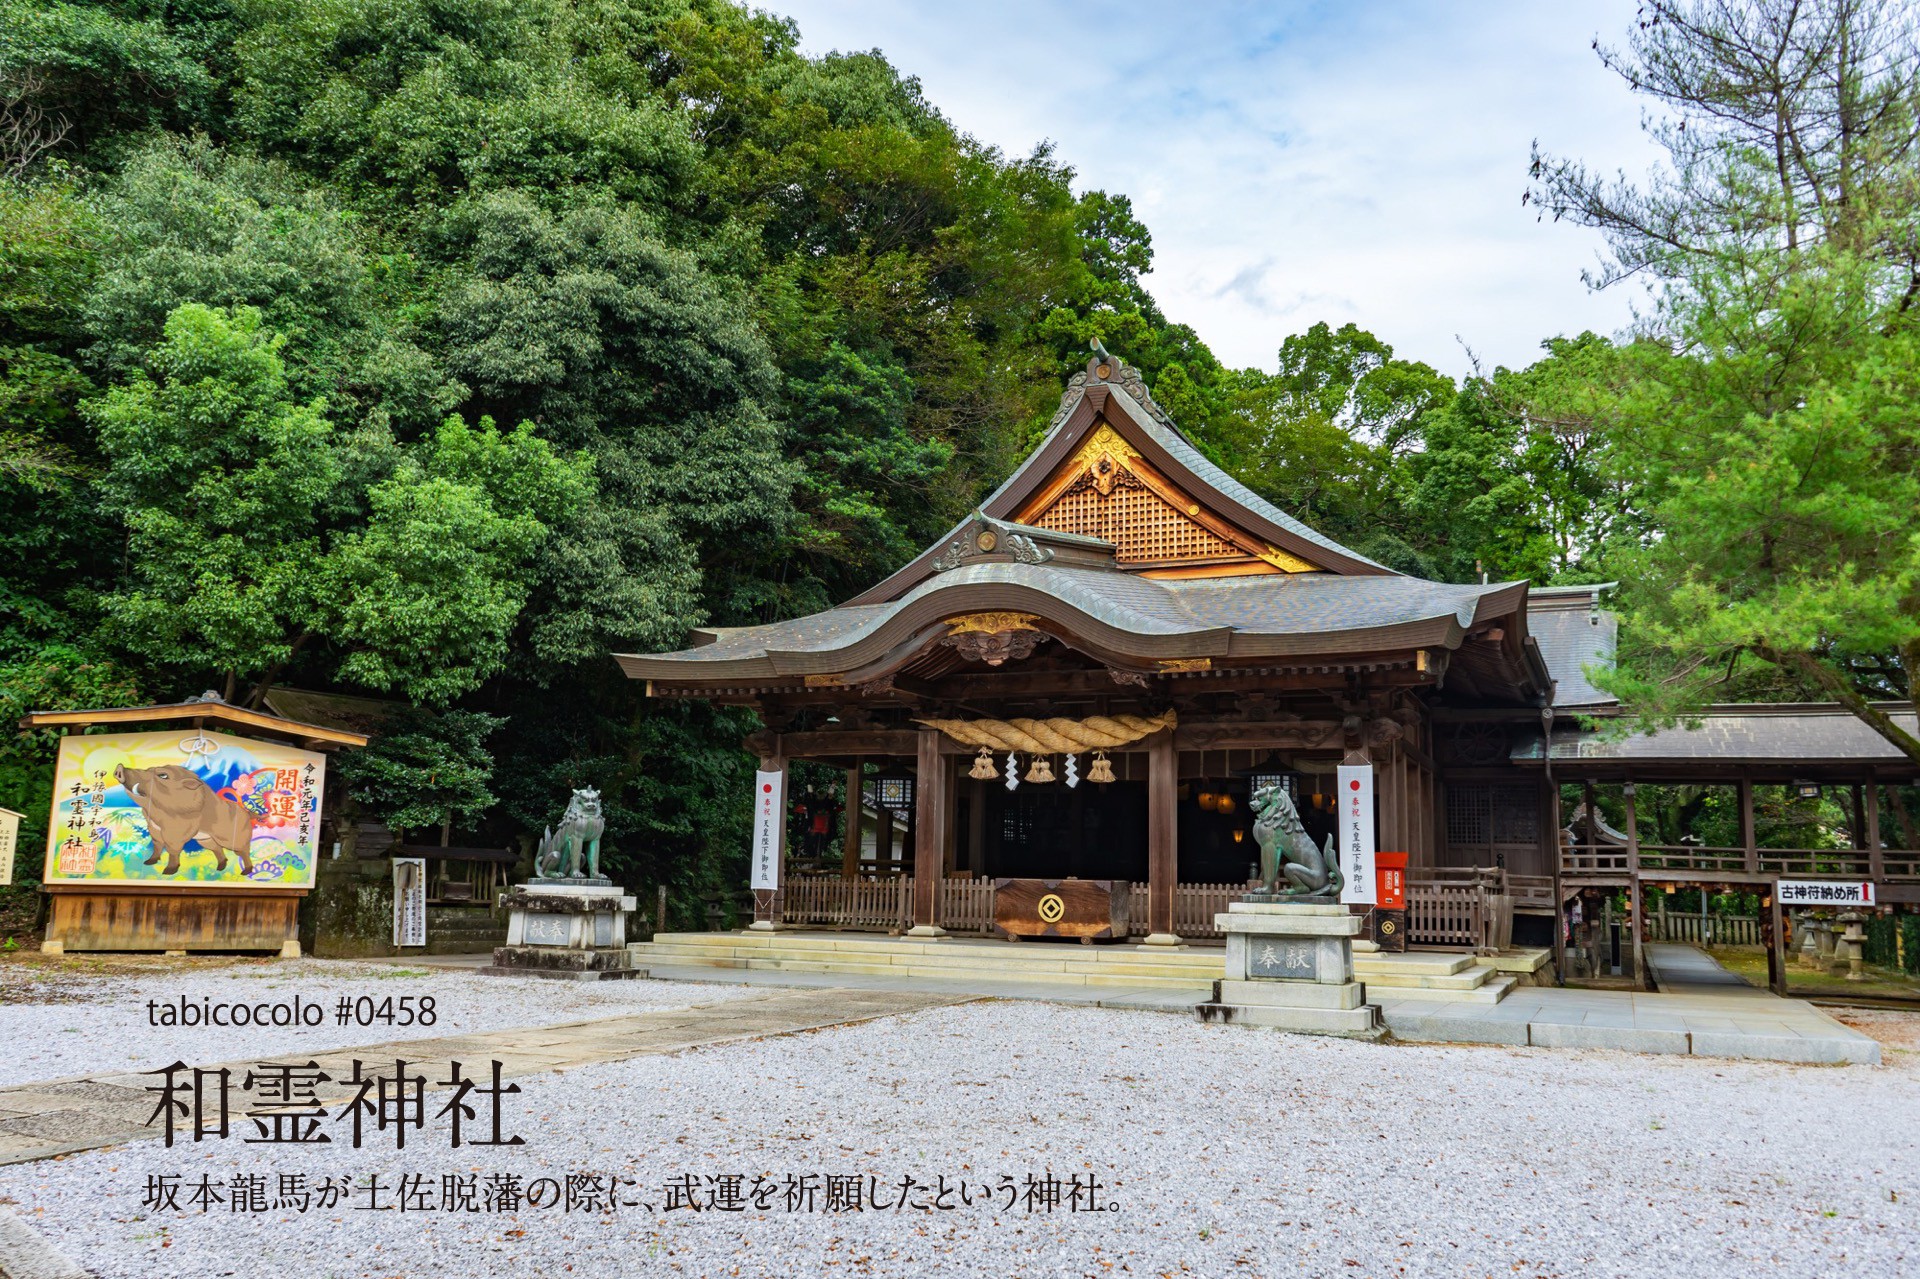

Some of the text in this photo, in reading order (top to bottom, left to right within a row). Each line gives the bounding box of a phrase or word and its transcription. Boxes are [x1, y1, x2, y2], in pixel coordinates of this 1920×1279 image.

[272, 769, 299, 819] 開運
[297, 763, 316, 846] 令和元年己亥年
[761, 798, 771, 881] 奉祝 天皇陛下御即位
[1351, 797, 1364, 894] 奉祝 天皇陛下御即位
[1781, 885, 1859, 901] 古神符納め所
